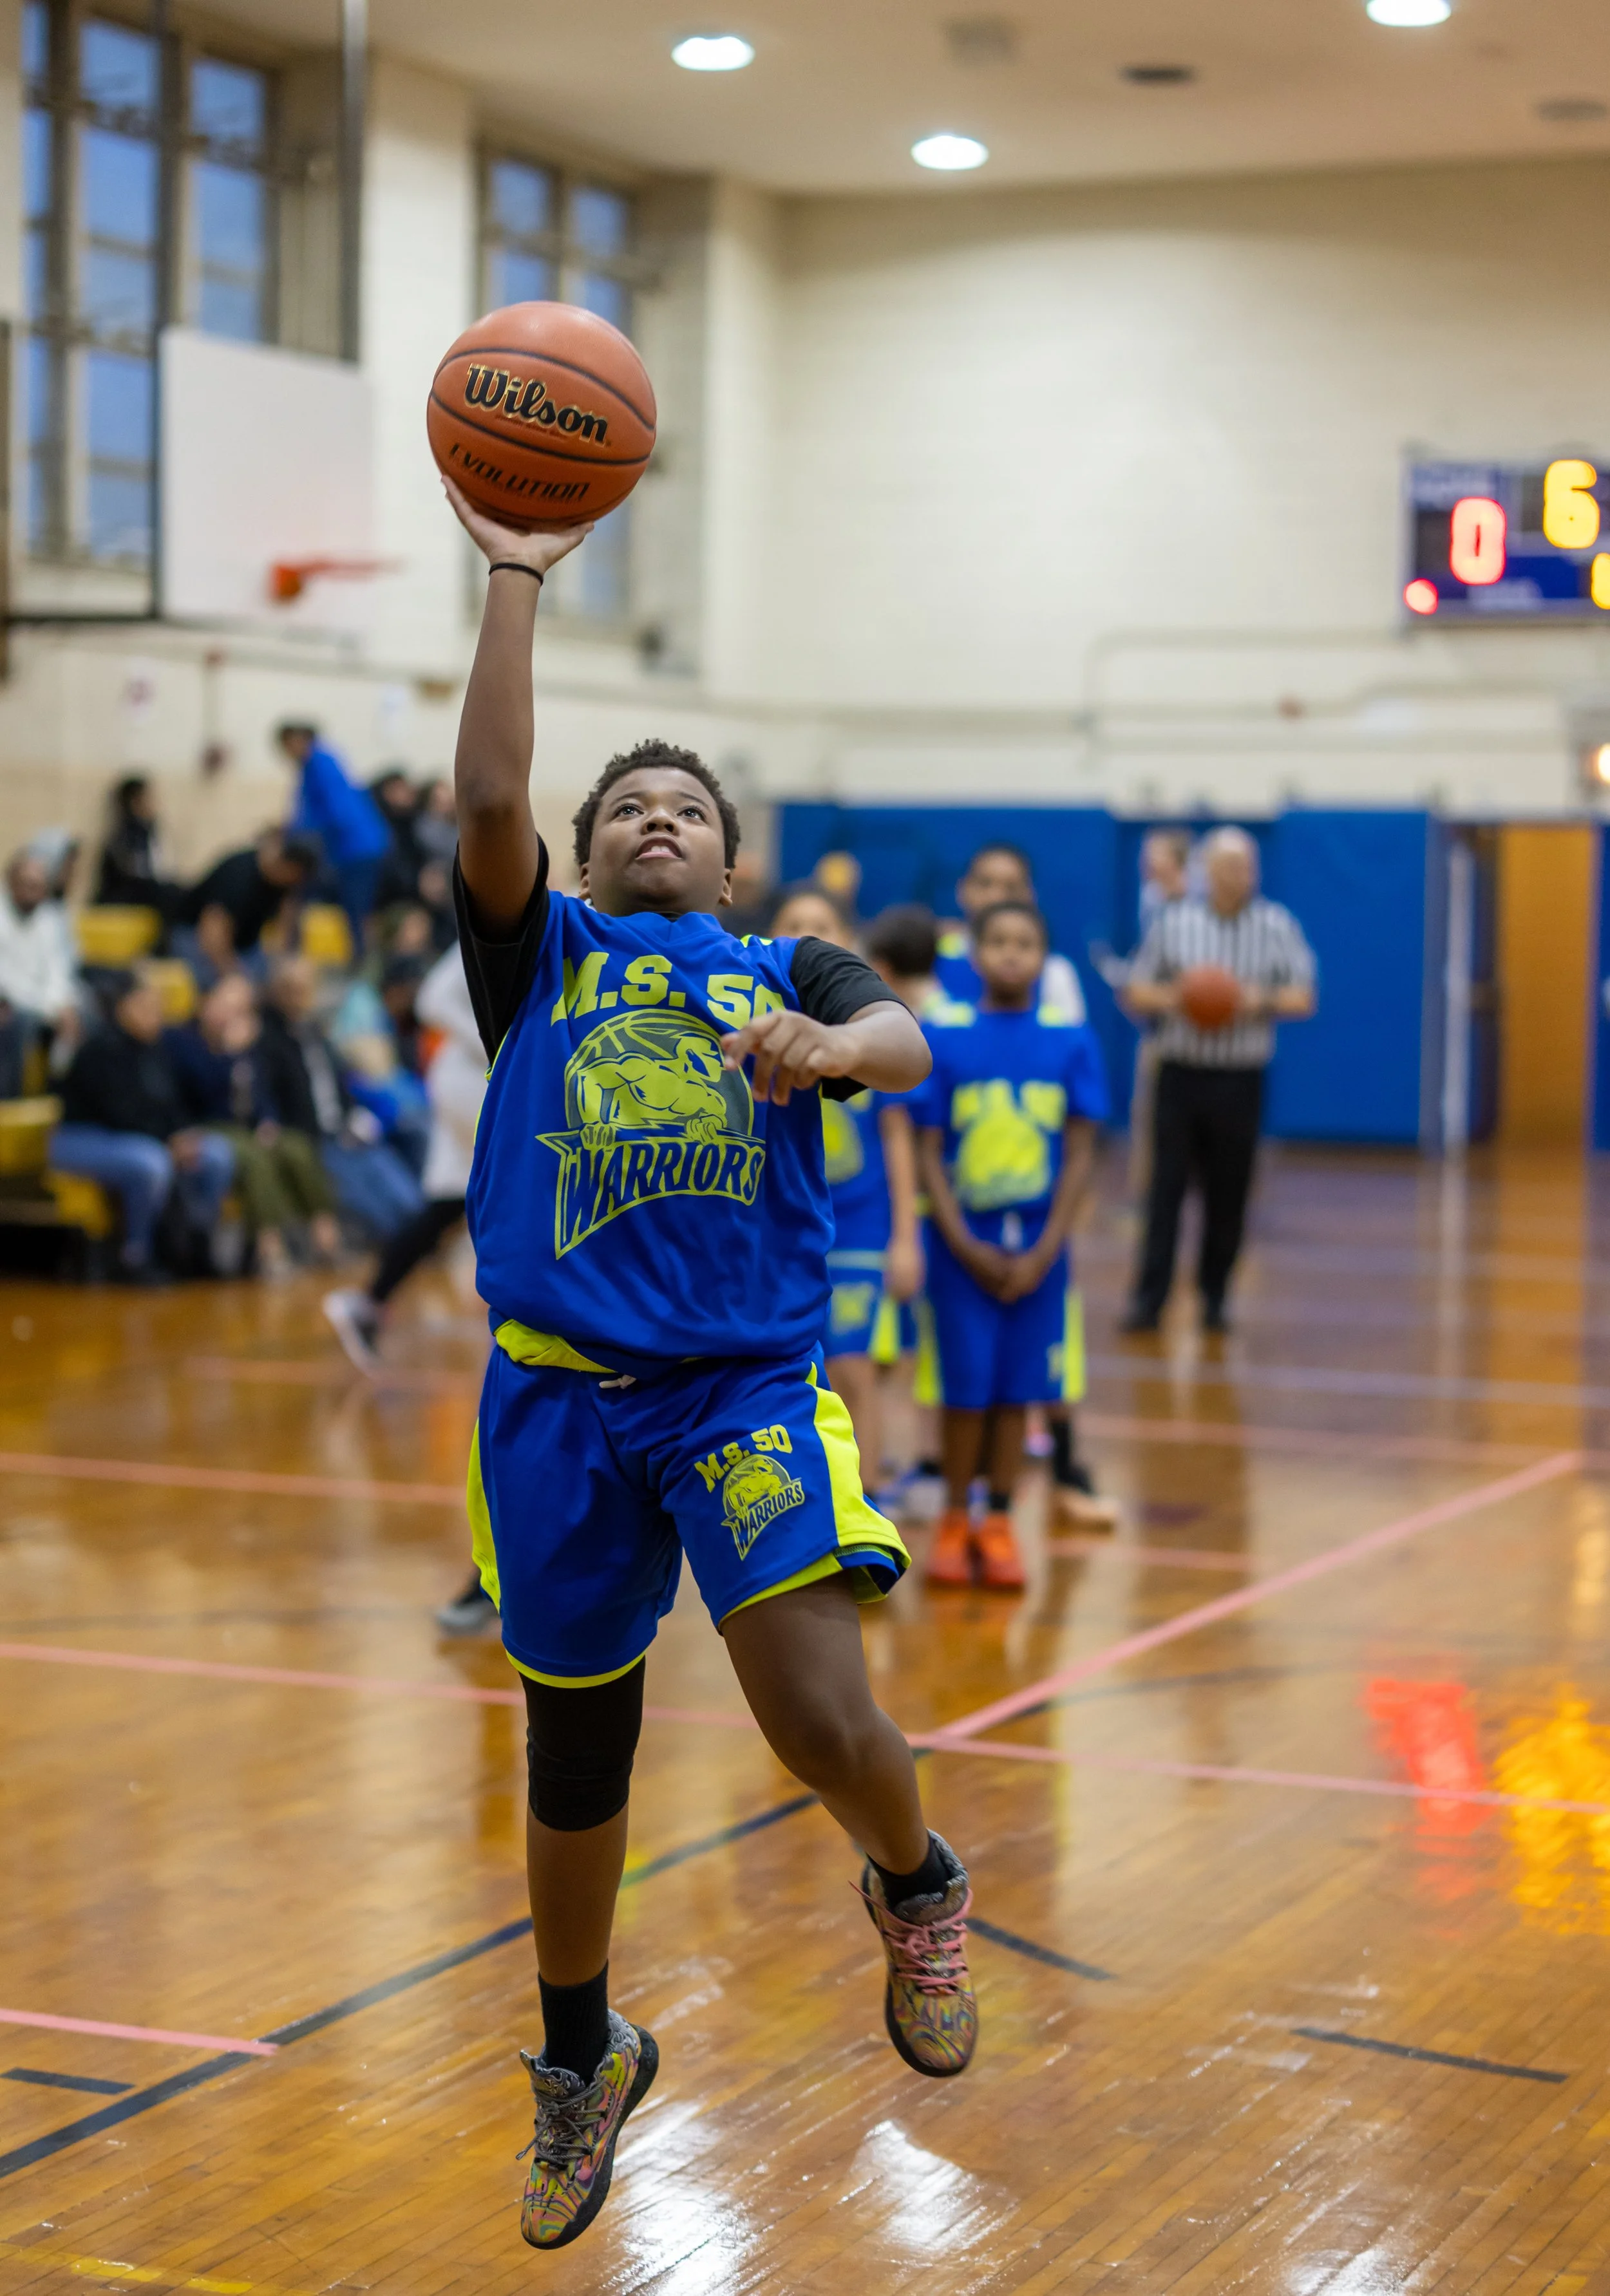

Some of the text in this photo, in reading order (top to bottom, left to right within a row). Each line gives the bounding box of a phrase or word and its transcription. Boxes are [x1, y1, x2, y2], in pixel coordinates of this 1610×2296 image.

[464, 362, 607, 446] Wilson
[1450, 496, 1506, 585] 0
[1543, 460, 1600, 549] 6
[551, 952, 686, 1027] M.S.
[557, 1142, 764, 1256] WARRIORS
[694, 1424, 793, 1493] M.S. 50
[733, 1483, 803, 1555] WARRIORS
